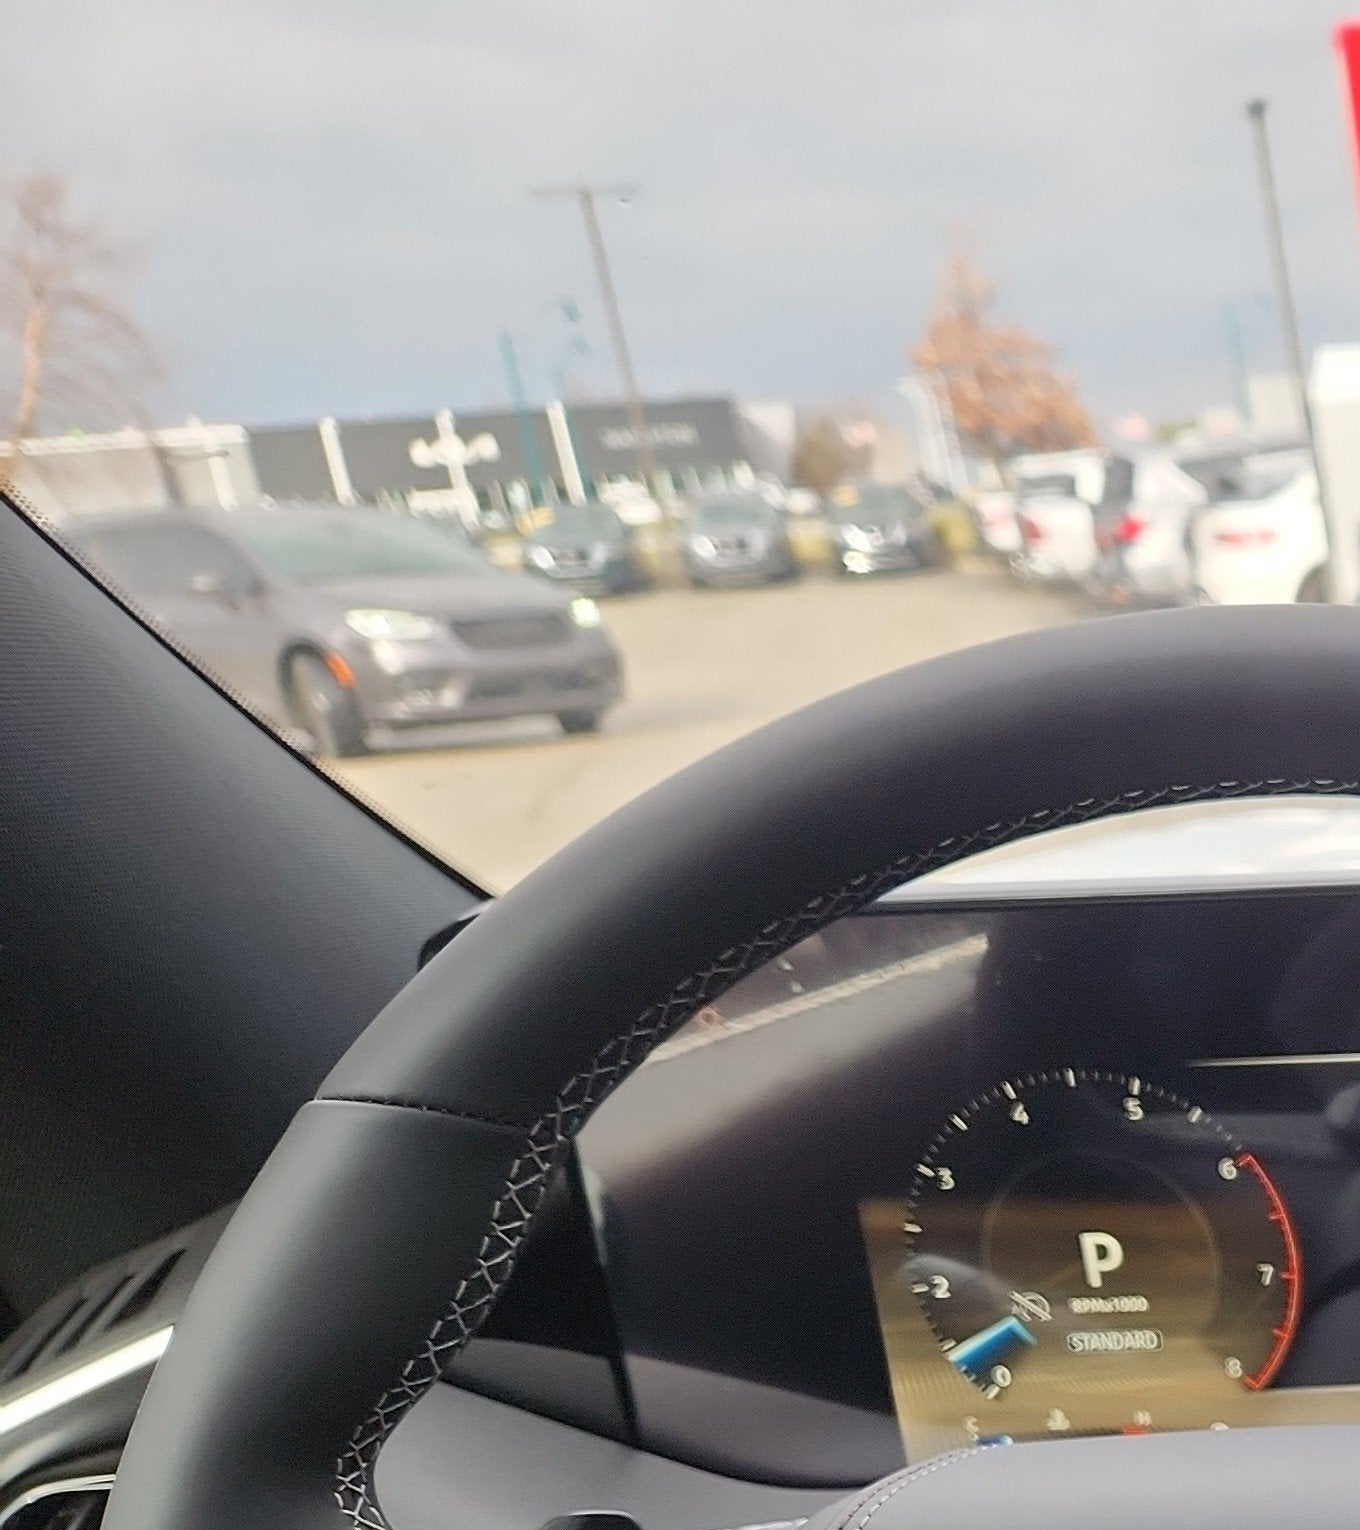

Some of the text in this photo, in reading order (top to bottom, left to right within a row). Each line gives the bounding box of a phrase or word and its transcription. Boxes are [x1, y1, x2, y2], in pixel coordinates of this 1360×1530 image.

[1012, 1102, 1030, 1125] 4
[1123, 1097, 1144, 1121] 5
[937, 1167, 955, 1190] 3
[1218, 1157, 1238, 1181] 6
[1078, 1231, 1124, 1288] P
[1257, 1263, 1274, 1286] 7
[930, 1275, 951, 1299] 2
[1069, 1331, 1158, 1352] STANDARD
[991, 1365, 1012, 1388] 0
[1224, 1356, 1243, 1379] 8
